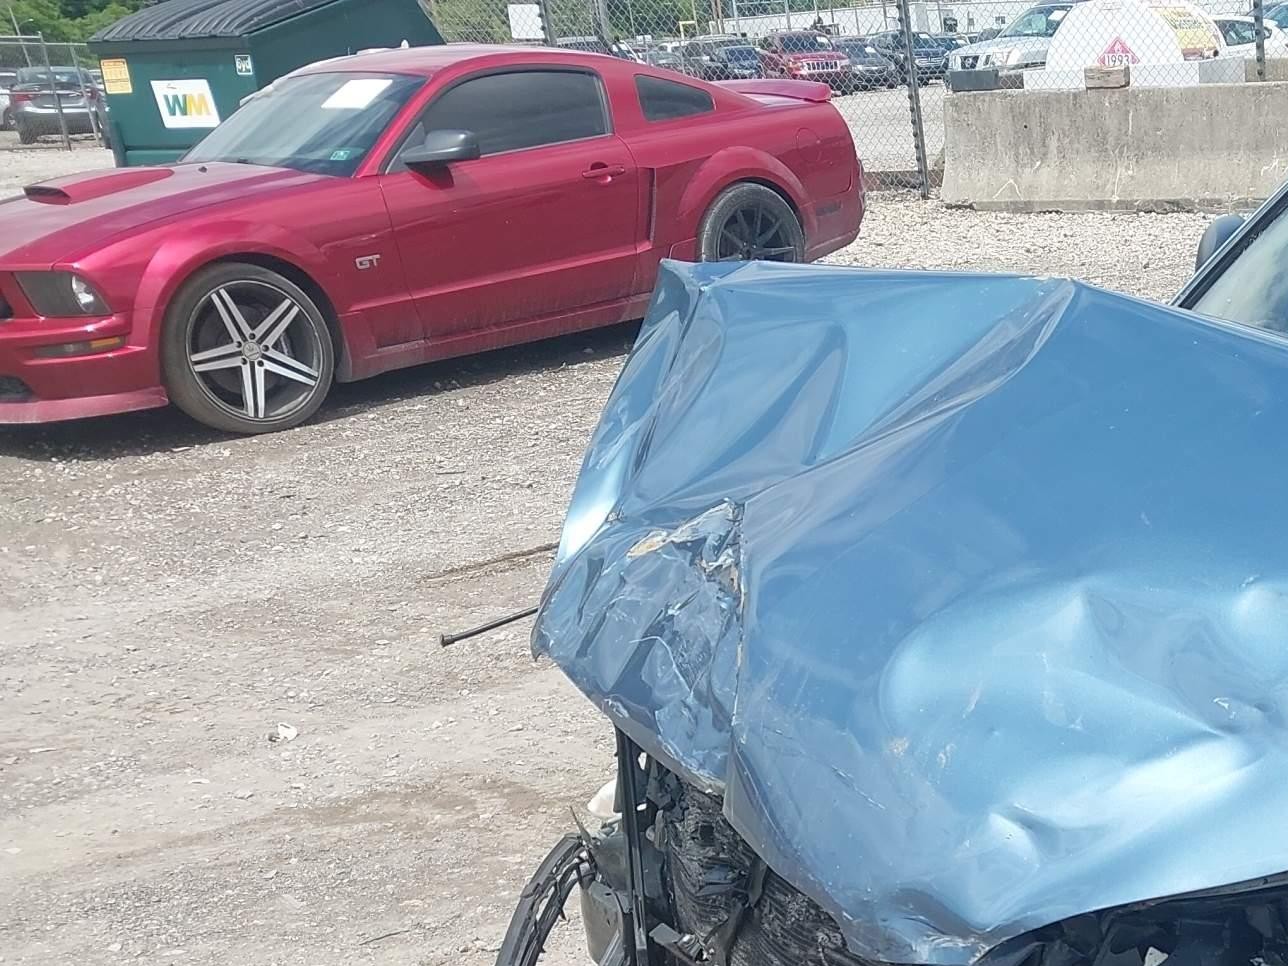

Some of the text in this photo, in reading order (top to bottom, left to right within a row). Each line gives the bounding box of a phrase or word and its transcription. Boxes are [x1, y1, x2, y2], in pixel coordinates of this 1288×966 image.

[1107, 54, 1130, 65] 1993
[163, 93, 211, 117] WM
[355, 254, 380, 269] GT
